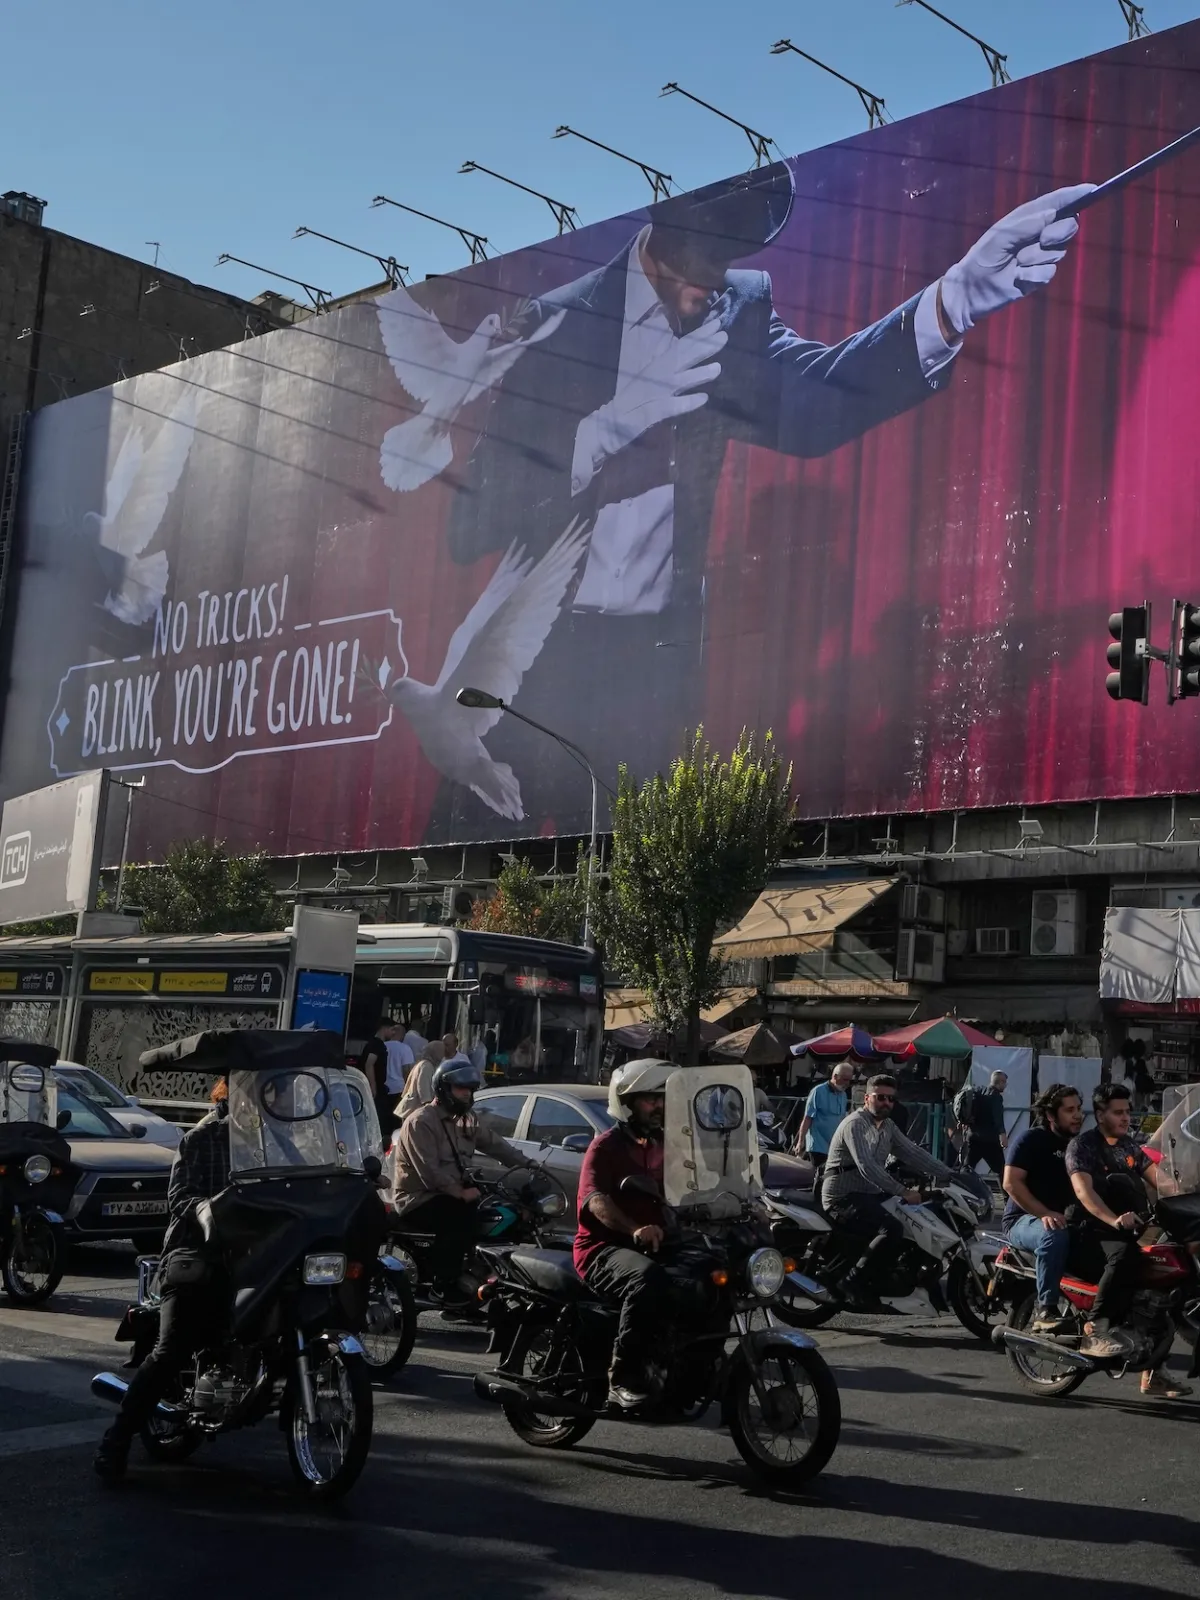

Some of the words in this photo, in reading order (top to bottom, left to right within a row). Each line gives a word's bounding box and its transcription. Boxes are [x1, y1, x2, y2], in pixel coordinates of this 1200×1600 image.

[152, 600, 189, 659] NO
[196, 573, 289, 649] TRICKS!
[81, 671, 161, 757] BLINK,
[173, 655, 262, 746] YOU'RE
[267, 638, 360, 734] GONE!
[6, 843, 28, 875] TCH
